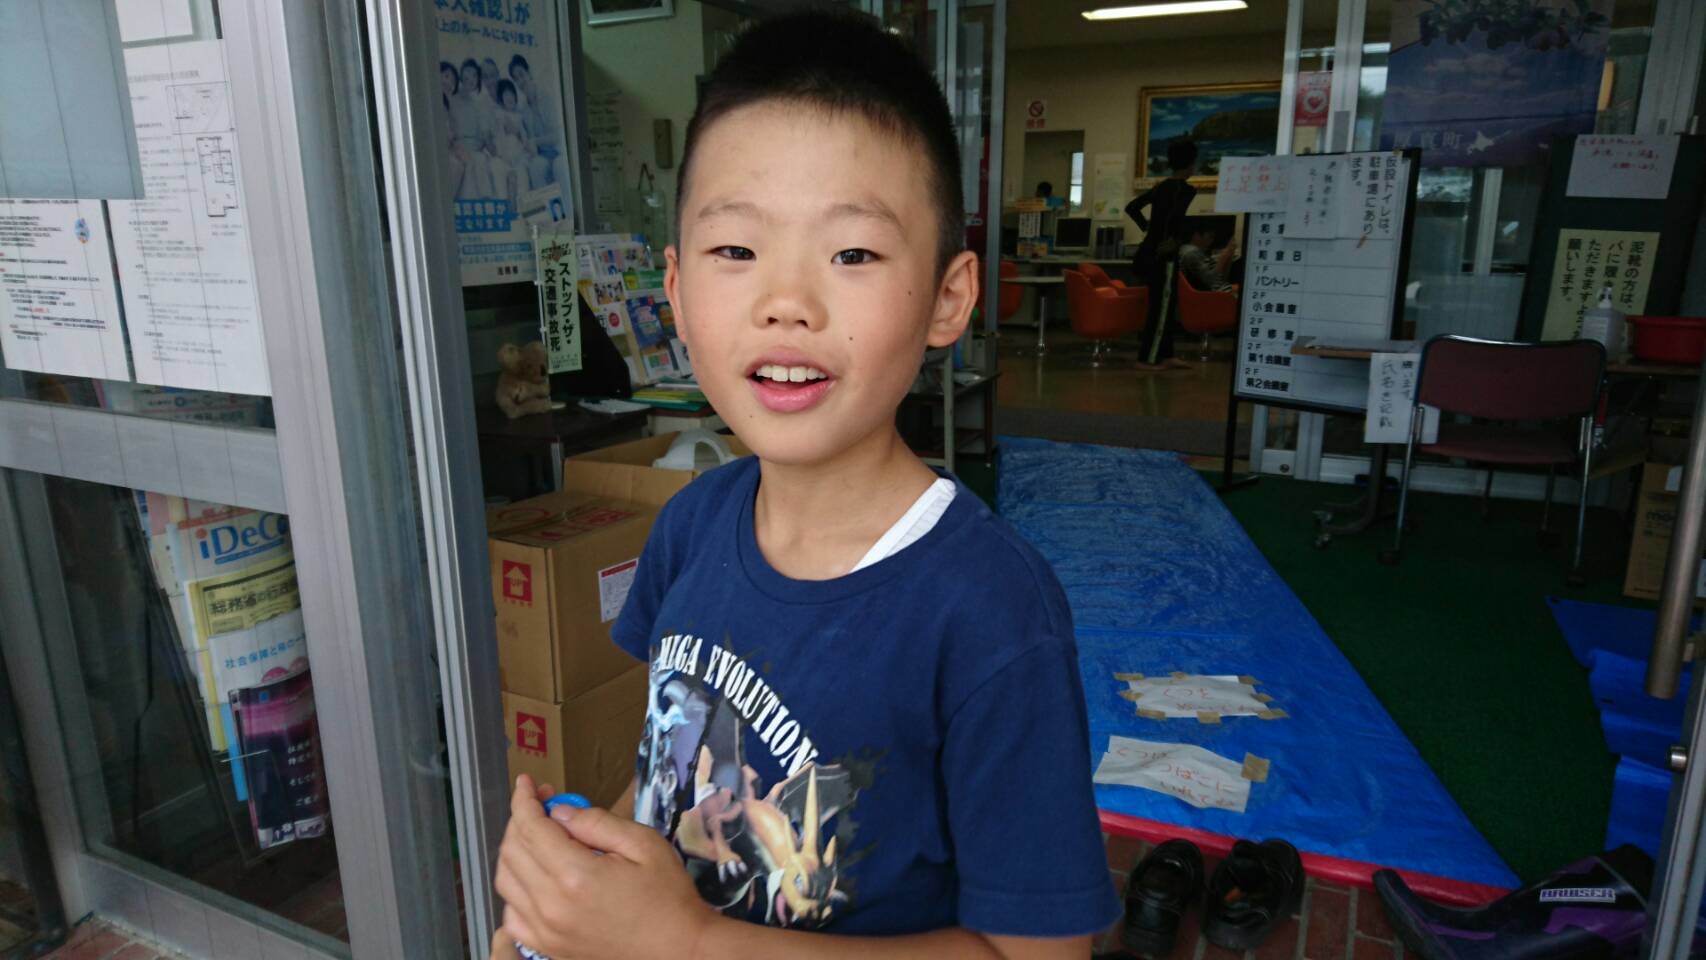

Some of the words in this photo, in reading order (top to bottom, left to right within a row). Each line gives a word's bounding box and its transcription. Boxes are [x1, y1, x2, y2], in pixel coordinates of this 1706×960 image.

[544, 268, 560, 352] 交通事故死
[1255, 275, 1300, 288] パントリー
[703, 645, 819, 777] EVOLUTION
